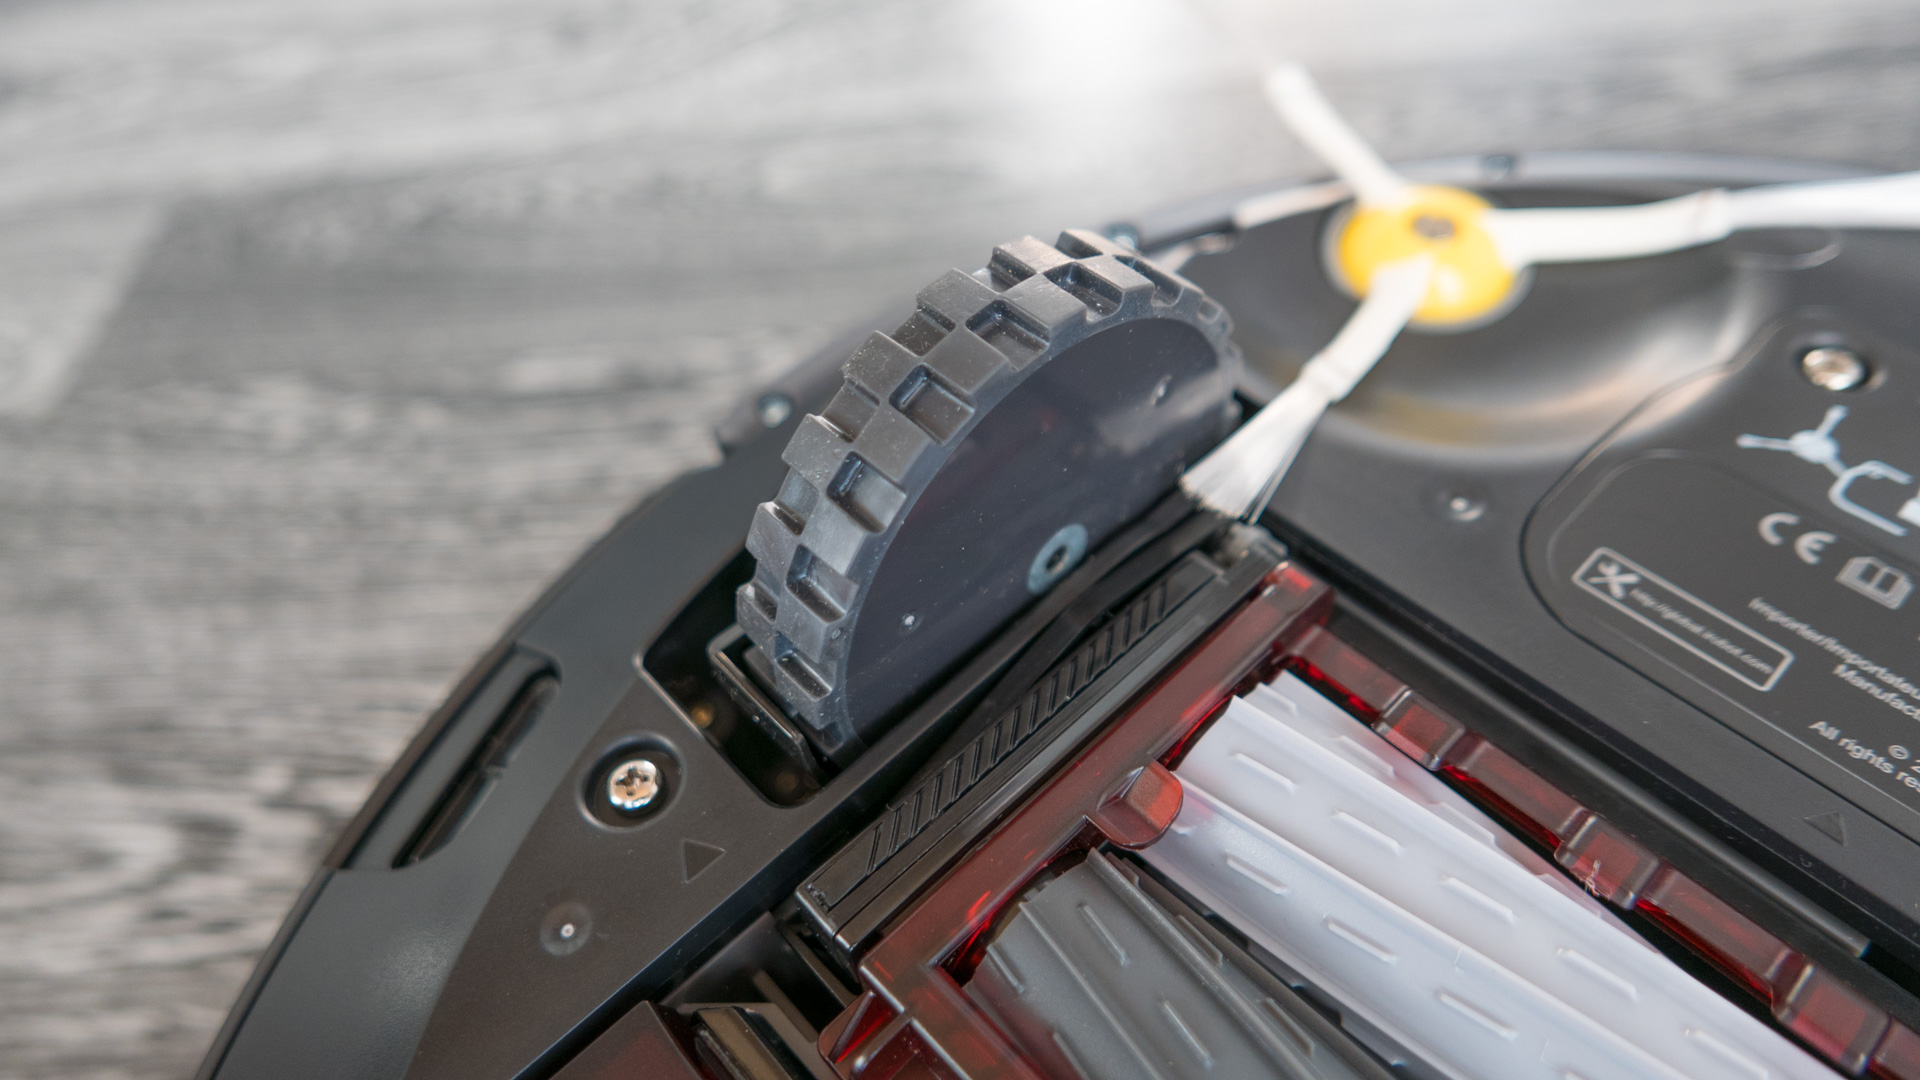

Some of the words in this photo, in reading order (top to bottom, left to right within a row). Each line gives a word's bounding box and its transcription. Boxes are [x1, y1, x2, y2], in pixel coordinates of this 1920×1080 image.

[1758, 512, 1837, 565] CE
[1808, 721, 1842, 741] All
[1838, 738, 1895, 774] rights
